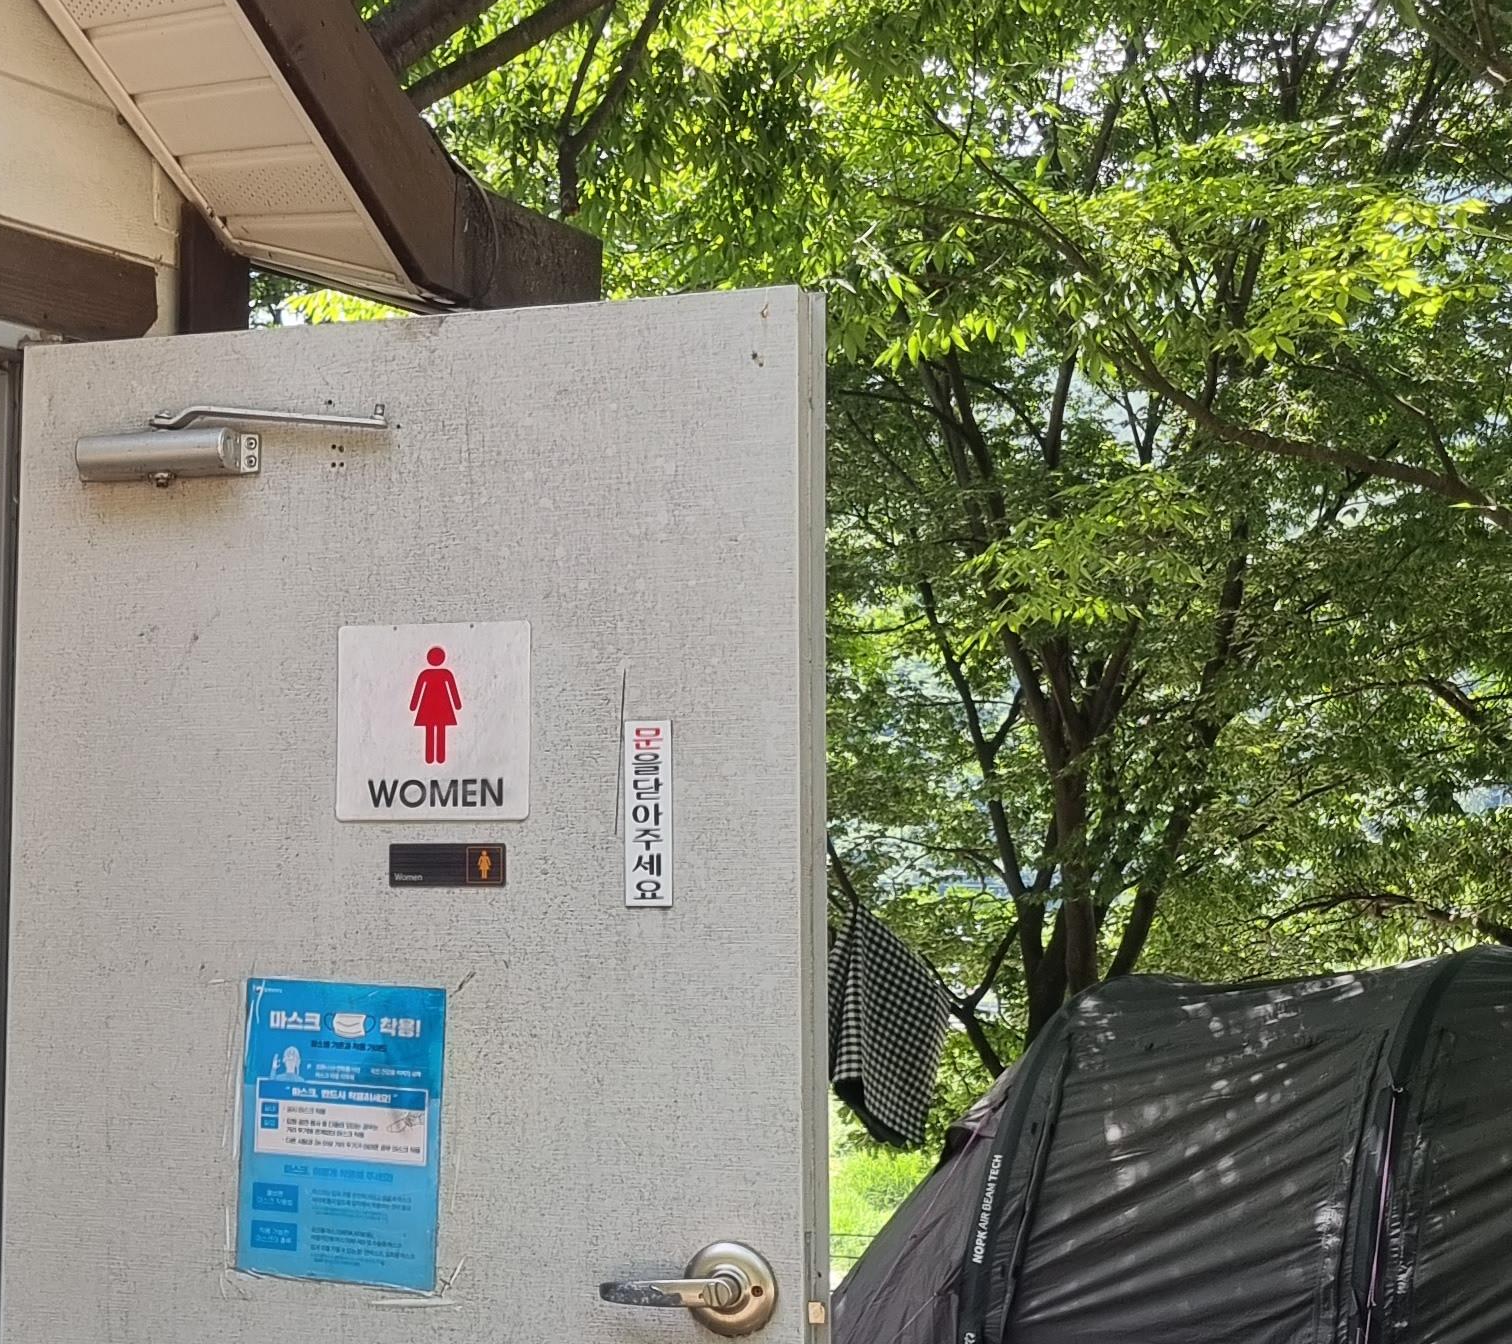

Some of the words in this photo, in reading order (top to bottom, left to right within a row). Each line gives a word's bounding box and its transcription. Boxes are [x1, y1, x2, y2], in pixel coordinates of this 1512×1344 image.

[367, 777, 504, 808] WOMEN
[393, 872, 424, 882] Women
[269, 1009, 321, 1032] 마스크
[988, 1154, 1003, 1183] TECH
[981, 1182, 997, 1212] BEAM
[978, 1212, 991, 1231] AIR
